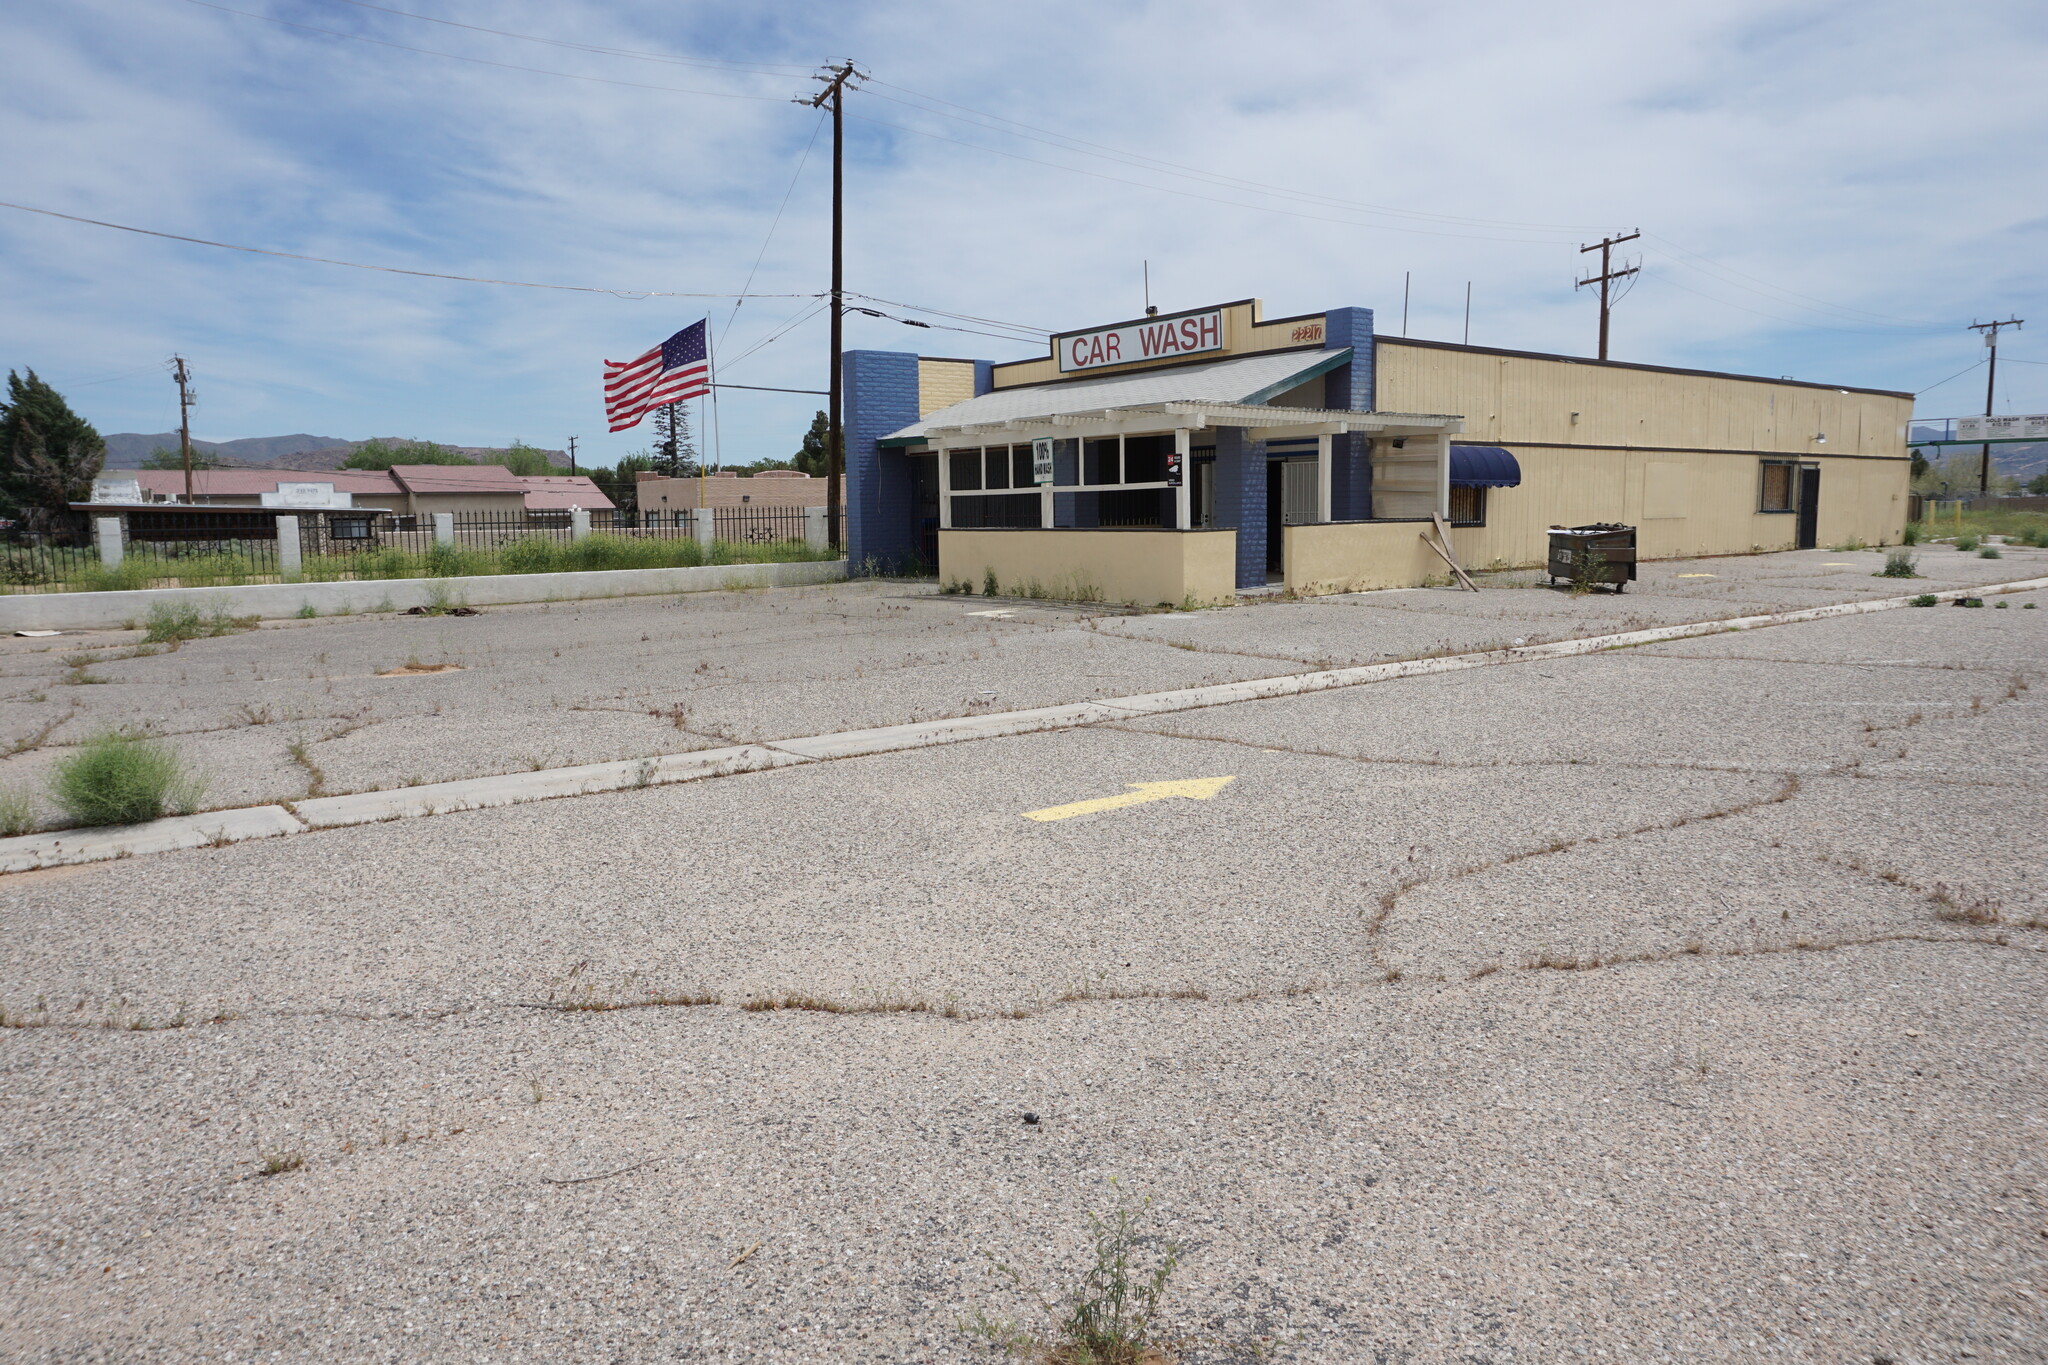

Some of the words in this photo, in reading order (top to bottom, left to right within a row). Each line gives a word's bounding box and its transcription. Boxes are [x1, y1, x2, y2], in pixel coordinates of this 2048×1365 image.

[1072, 333, 1121, 366] CAR
[1139, 315, 1218, 357] WASH
[1036, 441, 1049, 460] 100%
